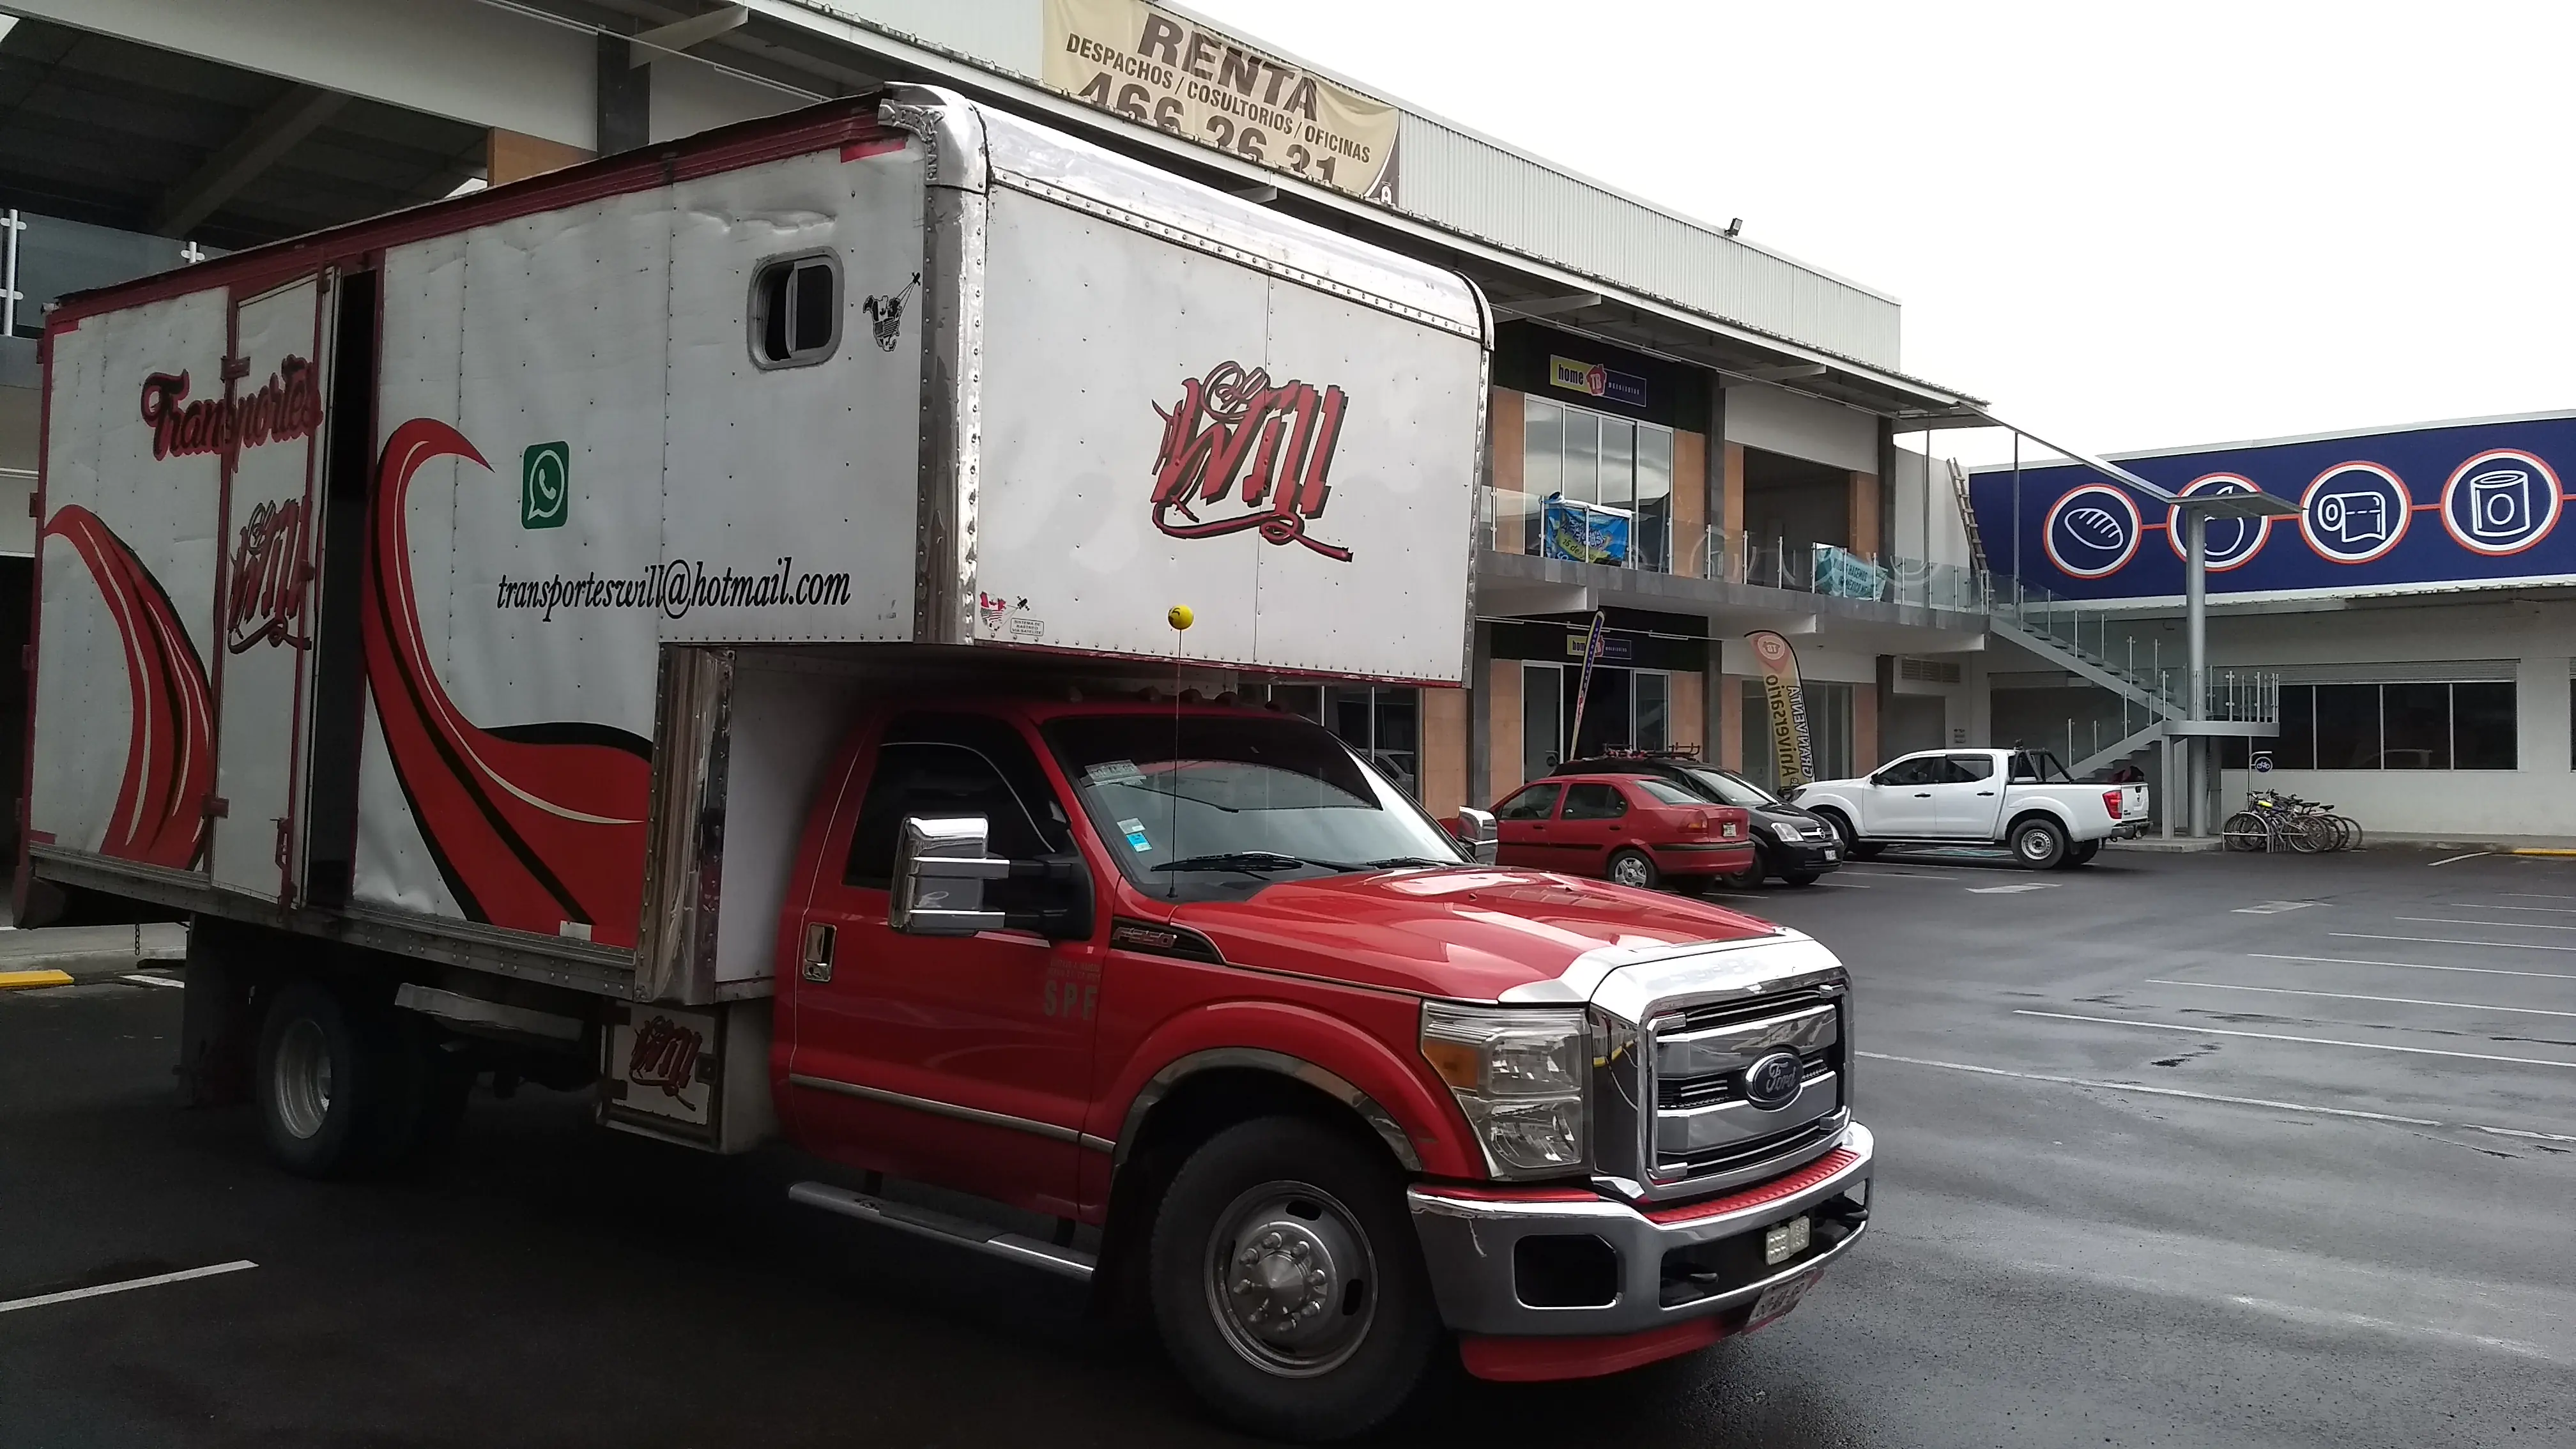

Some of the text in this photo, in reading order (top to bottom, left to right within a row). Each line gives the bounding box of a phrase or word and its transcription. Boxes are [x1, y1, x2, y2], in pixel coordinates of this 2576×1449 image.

[1137, 13, 1318, 121] RENTA
[1066, 33, 1173, 89] DESPACHOS
[1187, 80, 1293, 135] COSULTORIOS
[1305, 125, 1371, 164] OFICINAS
[1558, 364, 1584, 385] home
[497, 556, 851, 622] transporteswill@hotmail.com
[1572, 640, 1586, 651] hom
[1766, 1061, 1796, 1093] Ford
